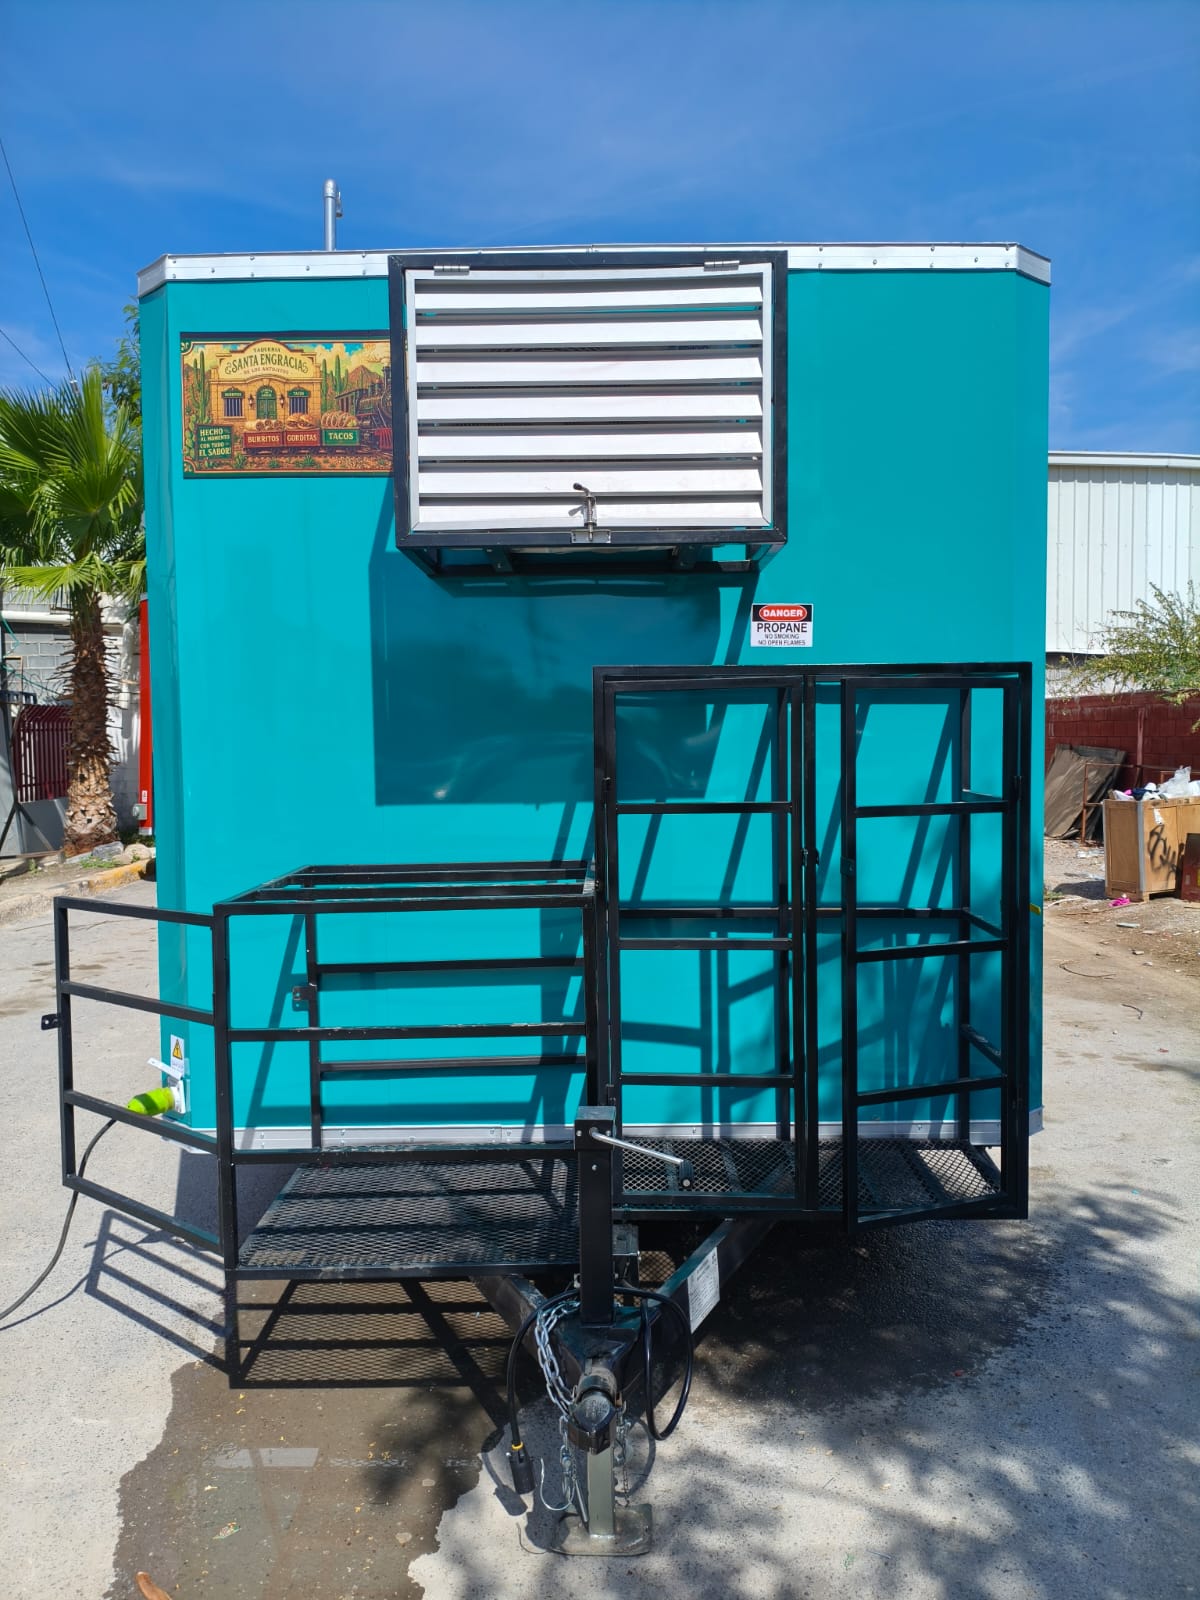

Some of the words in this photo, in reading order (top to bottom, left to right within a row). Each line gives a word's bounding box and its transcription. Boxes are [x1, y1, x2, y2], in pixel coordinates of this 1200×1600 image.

[231, 354, 259, 373] SANTA
[260, 353, 307, 373] ENGRACIA
[200, 428, 224, 437] HECHO
[328, 432, 354, 440] TACOS
[247, 435, 280, 443] BURRITOS
[286, 434, 318, 442] GORDITAS
[763, 609, 803, 617] DANGER
[756, 622, 808, 633] PROPANE
